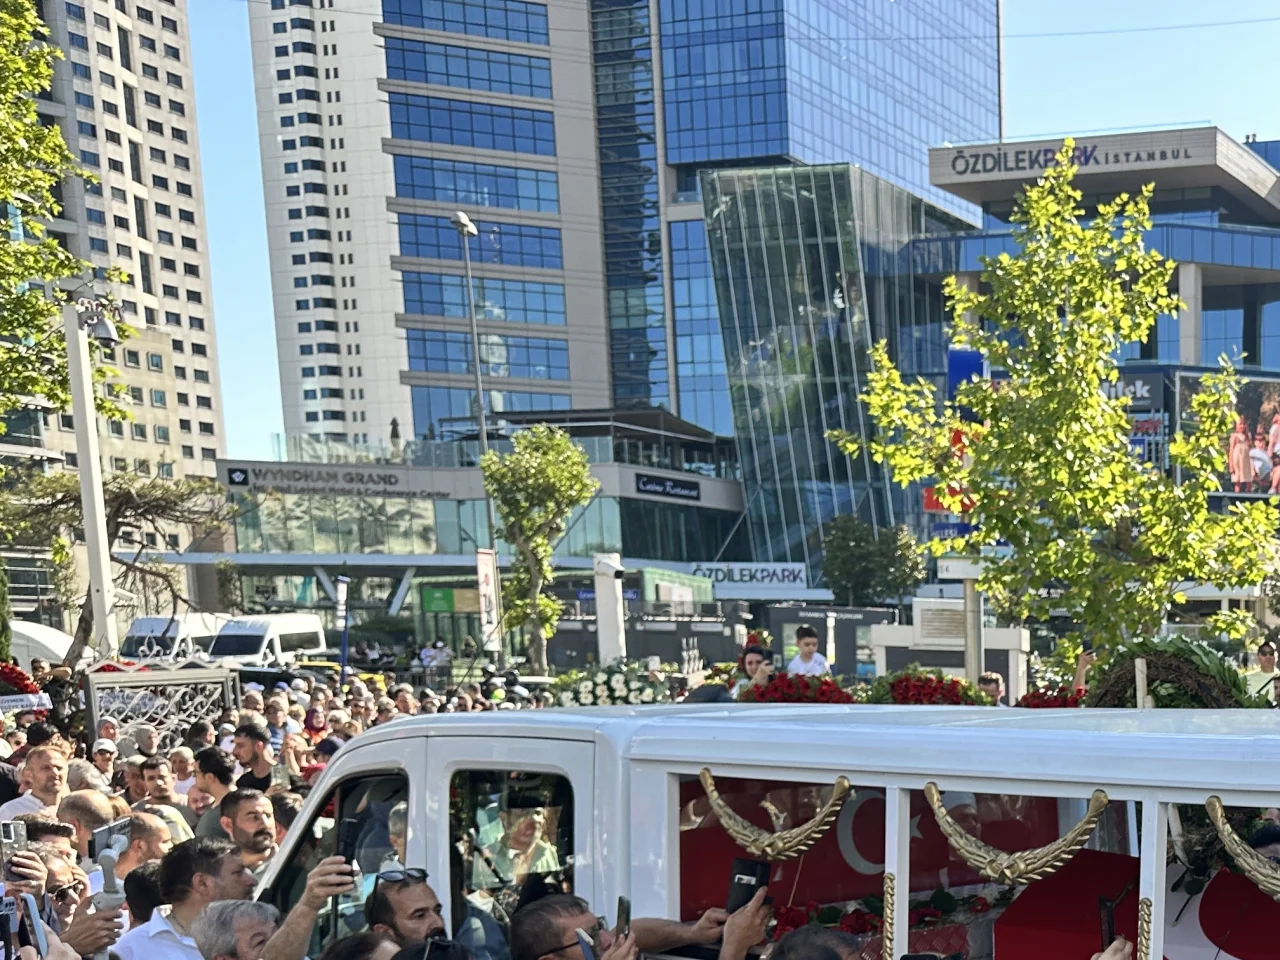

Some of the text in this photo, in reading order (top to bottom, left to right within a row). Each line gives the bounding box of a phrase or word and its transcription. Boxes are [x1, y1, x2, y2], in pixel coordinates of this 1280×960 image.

[1104, 148, 1193, 165] İSTANBUL
[252, 468, 399, 486] WYNDHAM GRAND
